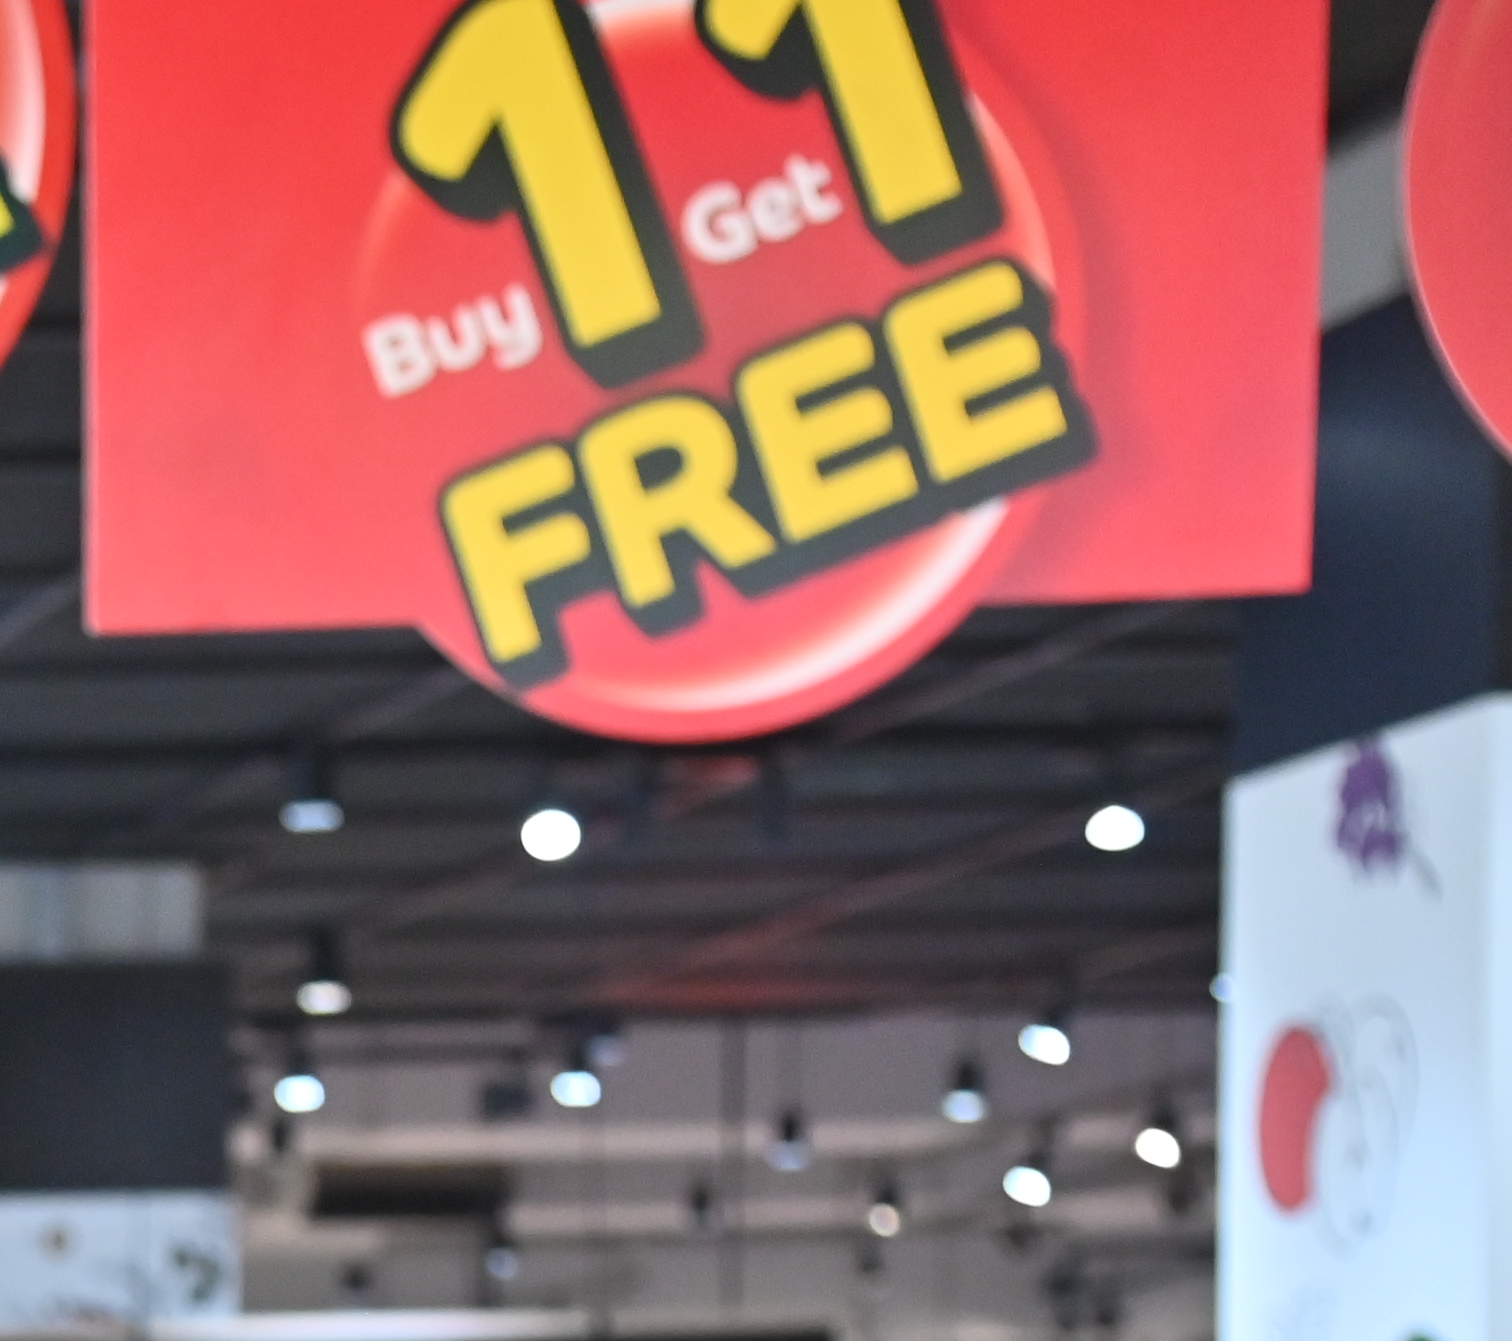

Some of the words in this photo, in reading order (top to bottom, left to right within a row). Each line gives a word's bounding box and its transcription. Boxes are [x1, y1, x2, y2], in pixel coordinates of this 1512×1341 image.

[398, 0, 664, 350] 1
[682, 154, 844, 265] Get
[361, 284, 544, 398] Buy
[439, 258, 1069, 666] FREE
